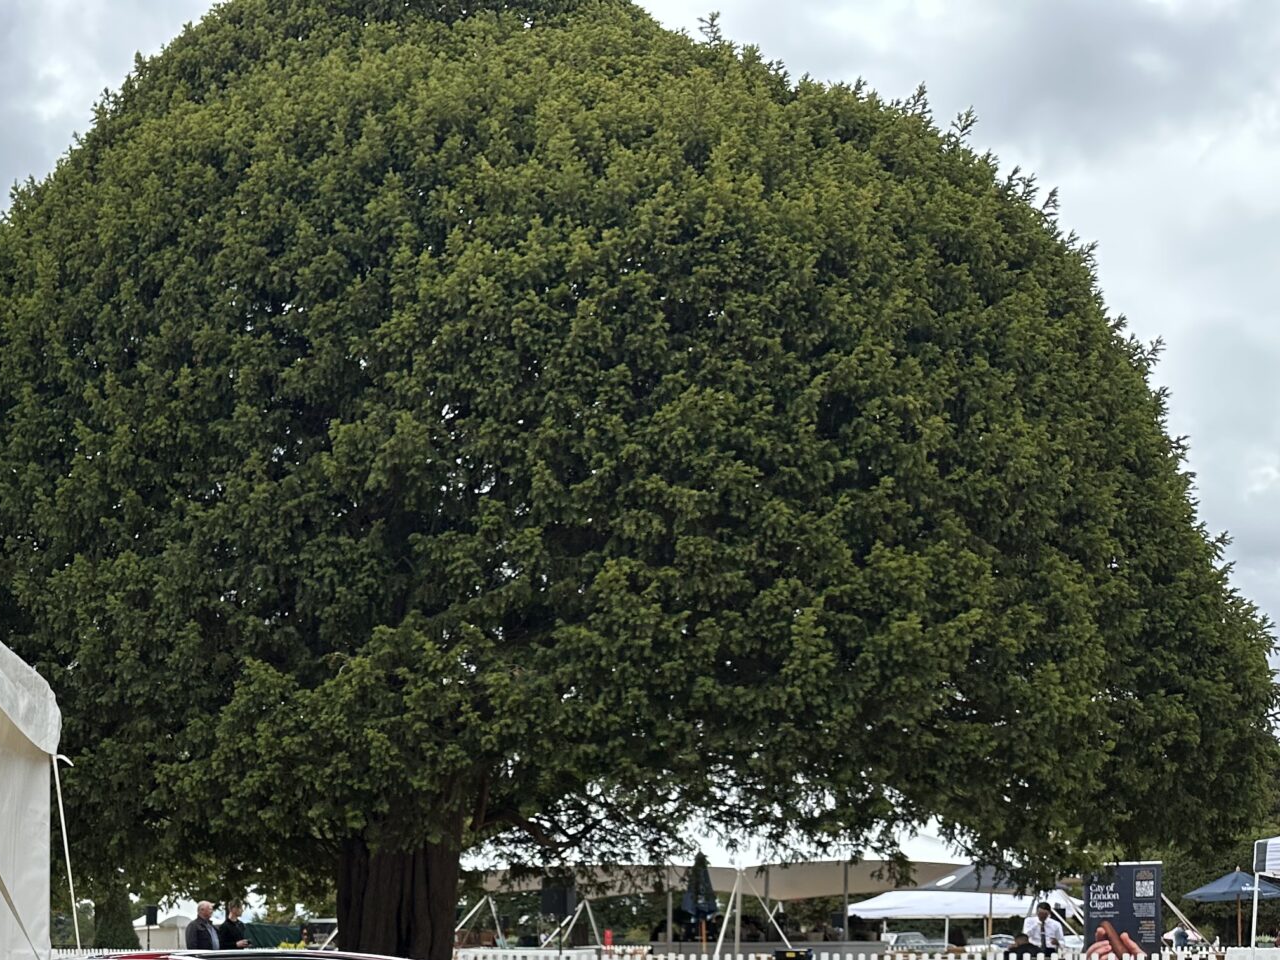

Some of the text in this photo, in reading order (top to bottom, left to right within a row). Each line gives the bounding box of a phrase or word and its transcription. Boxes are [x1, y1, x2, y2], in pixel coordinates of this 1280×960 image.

[1089, 882, 1115, 893] City of
[1089, 892, 1120, 900] London
[1089, 900, 1114, 909] Cigars
